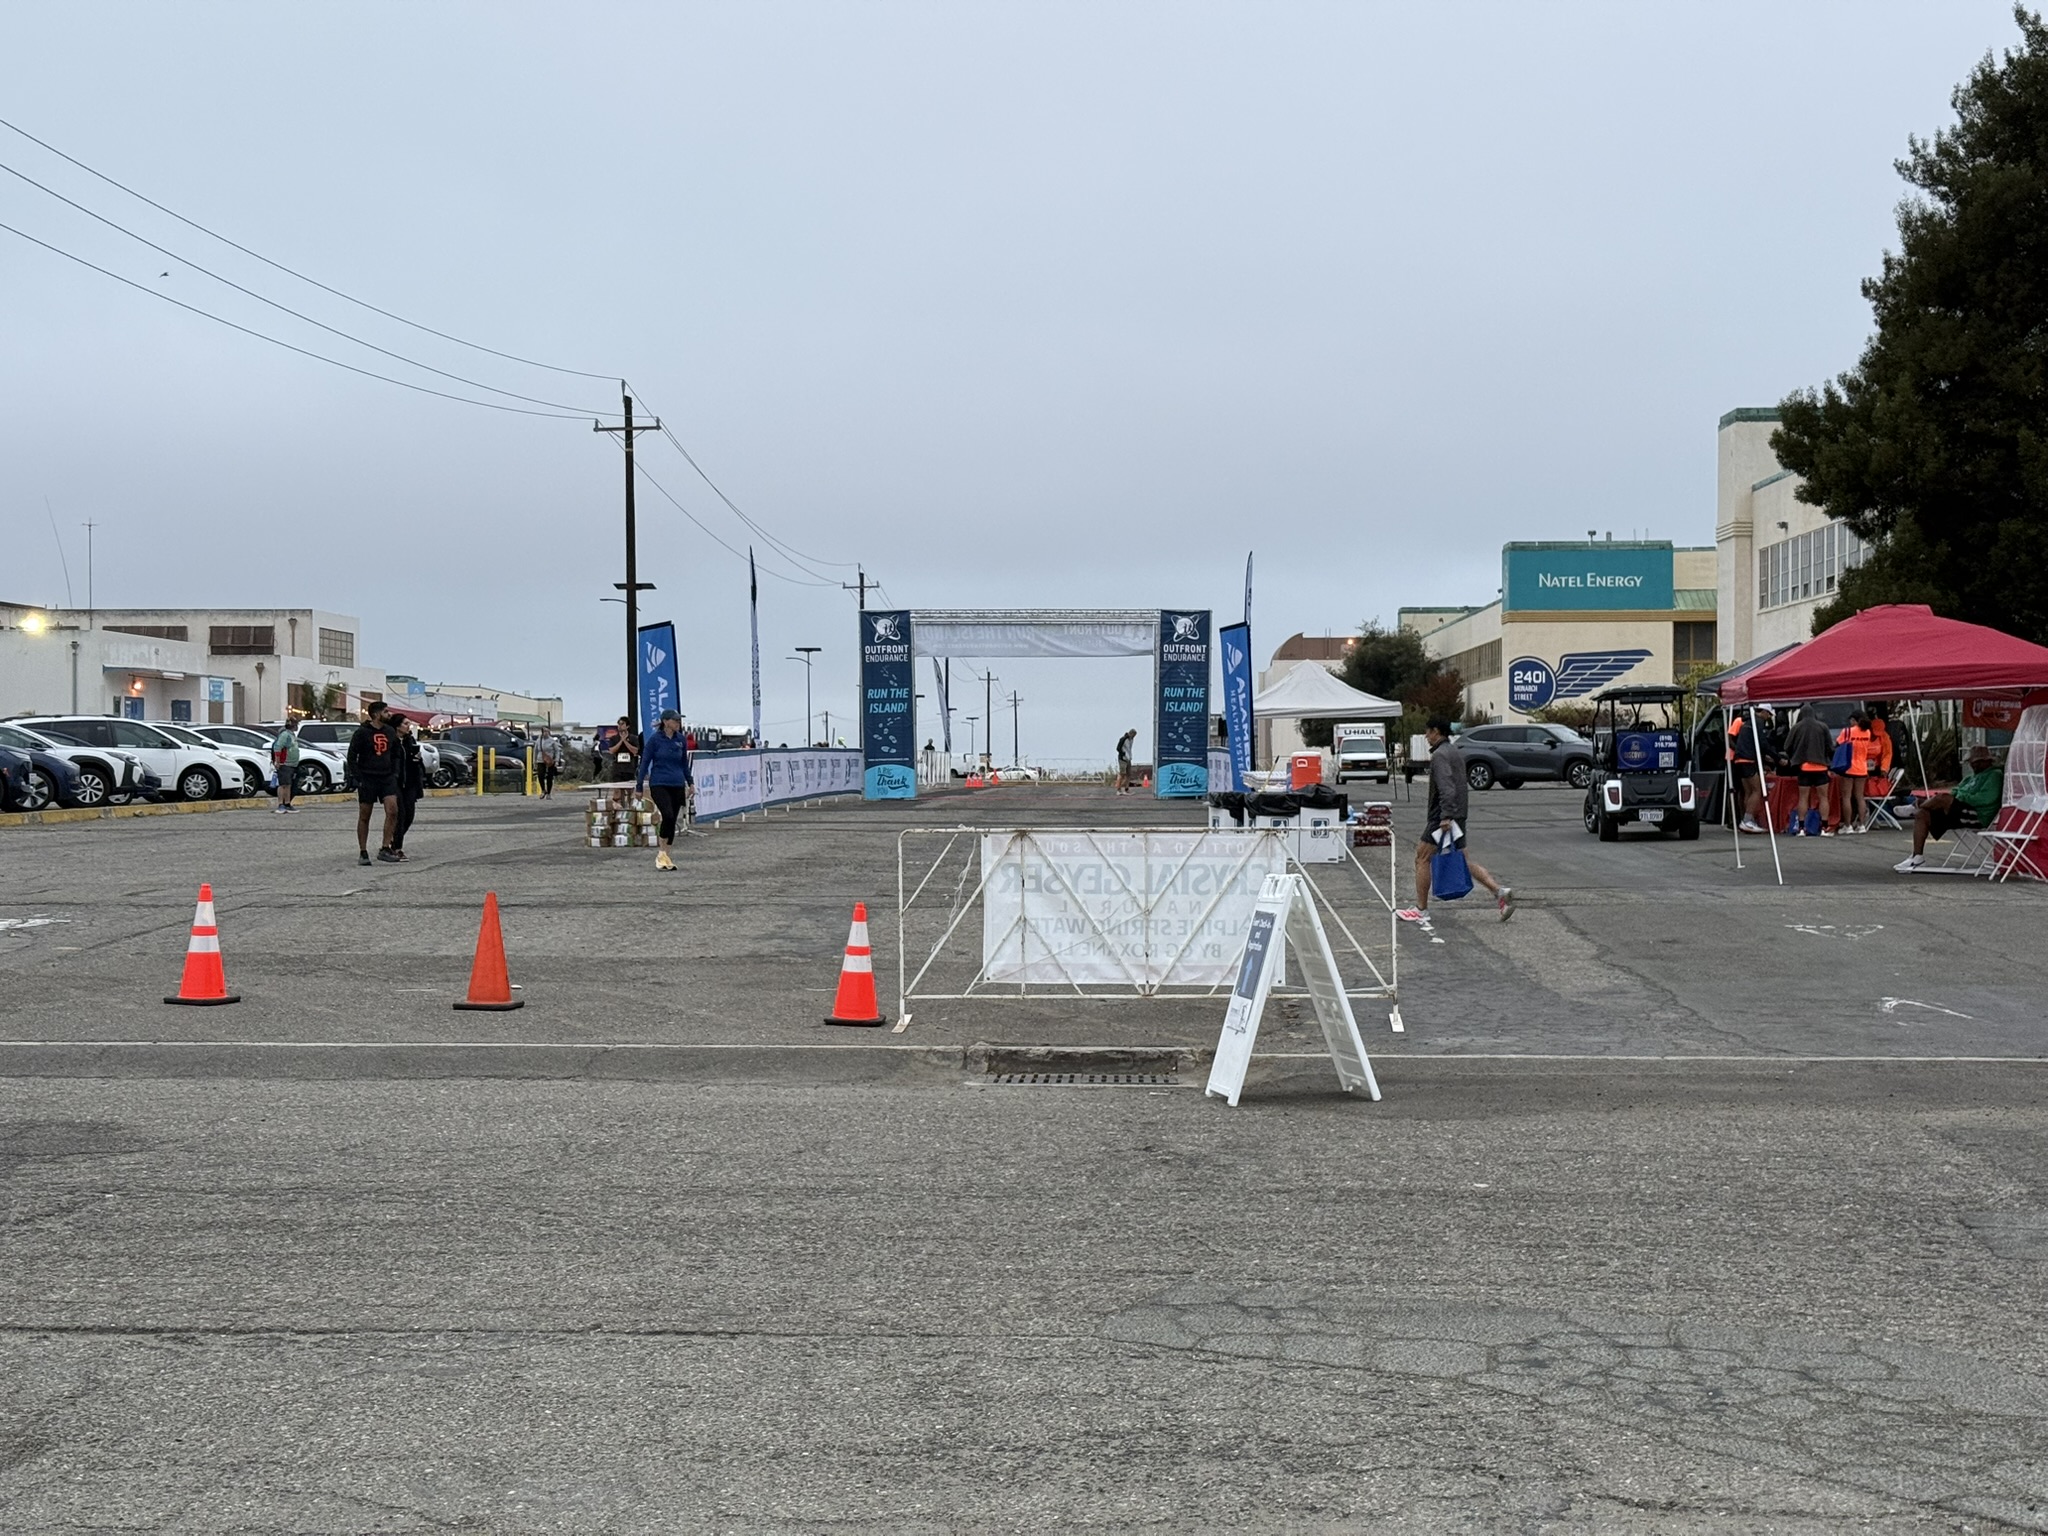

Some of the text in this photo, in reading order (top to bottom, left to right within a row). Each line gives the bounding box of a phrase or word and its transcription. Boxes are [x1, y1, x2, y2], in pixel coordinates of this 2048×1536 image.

[865, 644, 909, 654] OUTFRONT
[1163, 644, 1207, 654] OUTFRONT
[865, 654, 909, 663] ENDURANCE
[1163, 653, 1206, 662] ENDURANCE
[1514, 670, 1546, 684] 2401
[867, 688, 909, 699] RUN THE
[1164, 687, 1205, 698] RUN THE
[1514, 693, 1533, 701] STREET
[869, 702, 908, 714] ISLAND!
[1165, 701, 1203, 713] ISLAND!
[1230, 690, 1239, 732] HEALTH
[1236, 677, 1250, 772] ALAMED
[877, 774, 910, 790] Thank
[1169, 772, 1202, 788] Thank
